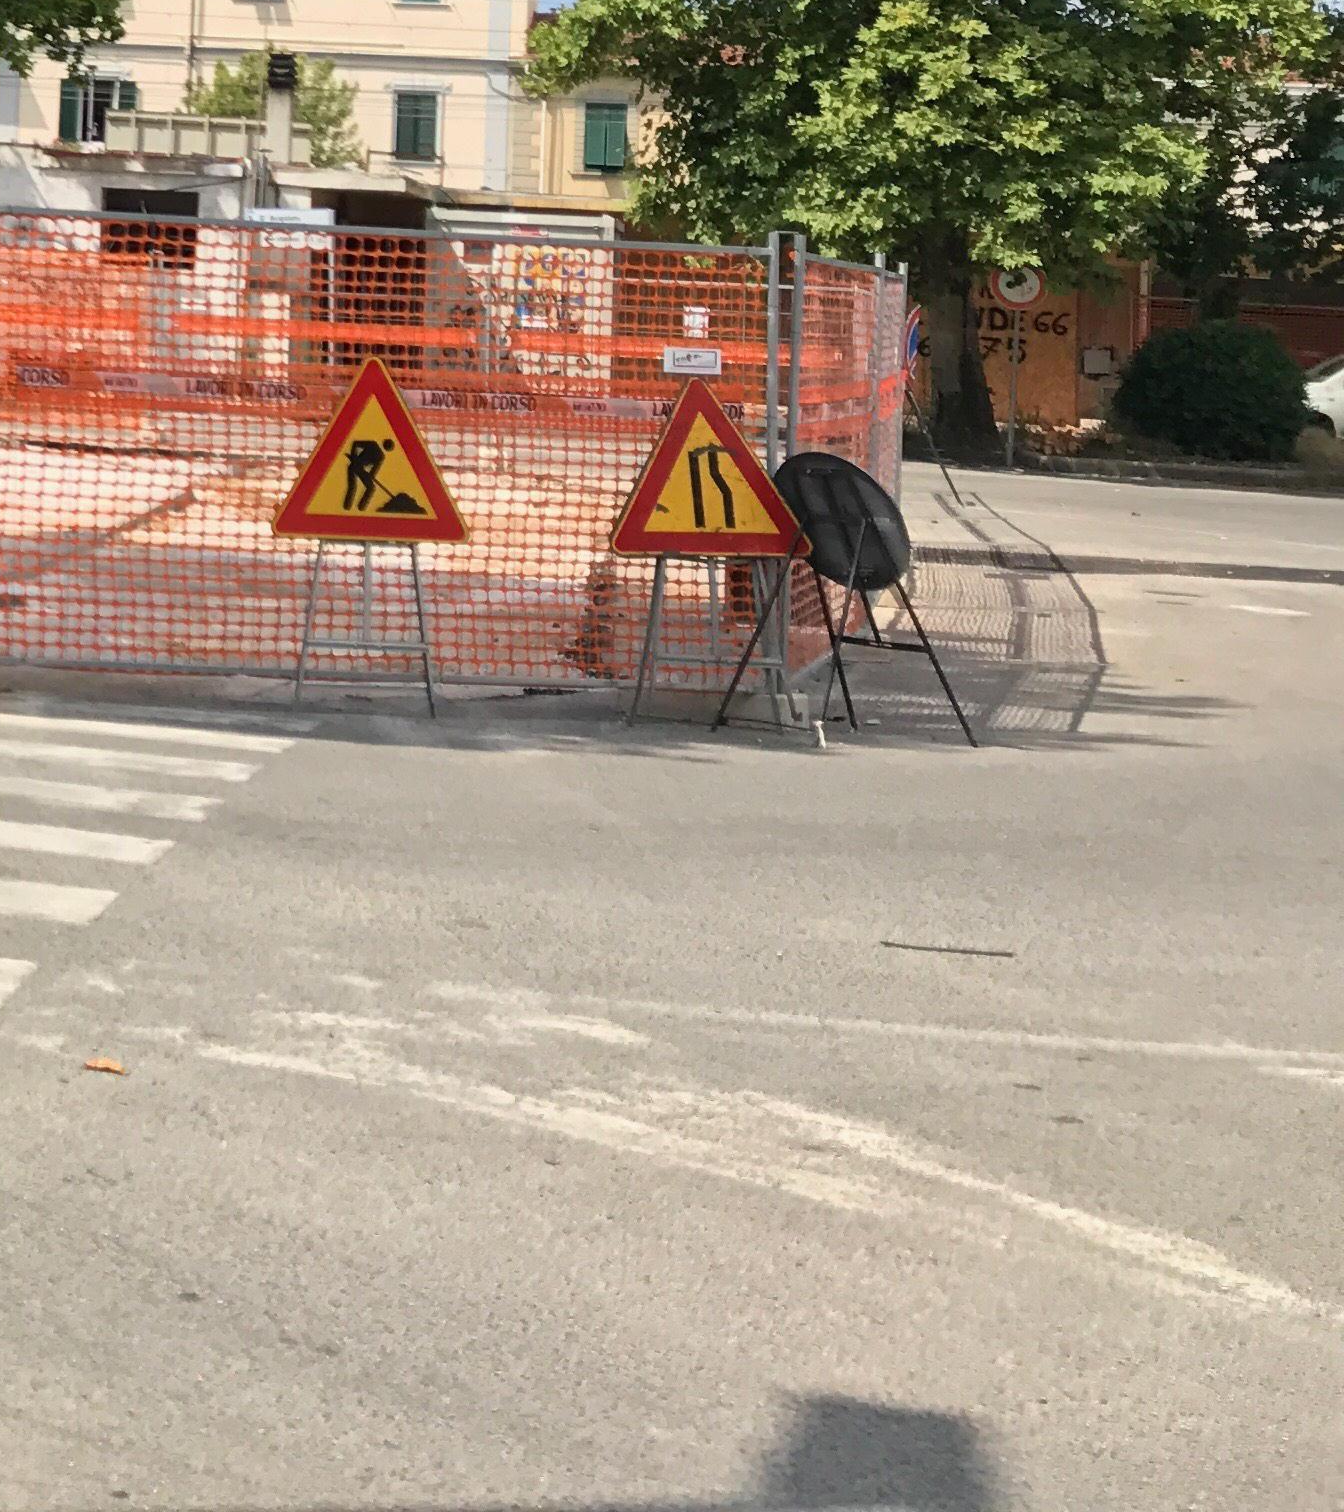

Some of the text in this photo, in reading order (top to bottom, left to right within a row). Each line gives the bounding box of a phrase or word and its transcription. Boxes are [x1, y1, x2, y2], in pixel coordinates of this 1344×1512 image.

[18, 367, 70, 387] CORSO
[185, 378, 233, 397] LAVORI
[260, 383, 308, 401] CORSO
[421, 391, 538, 412] LAVORI IN CORSO
